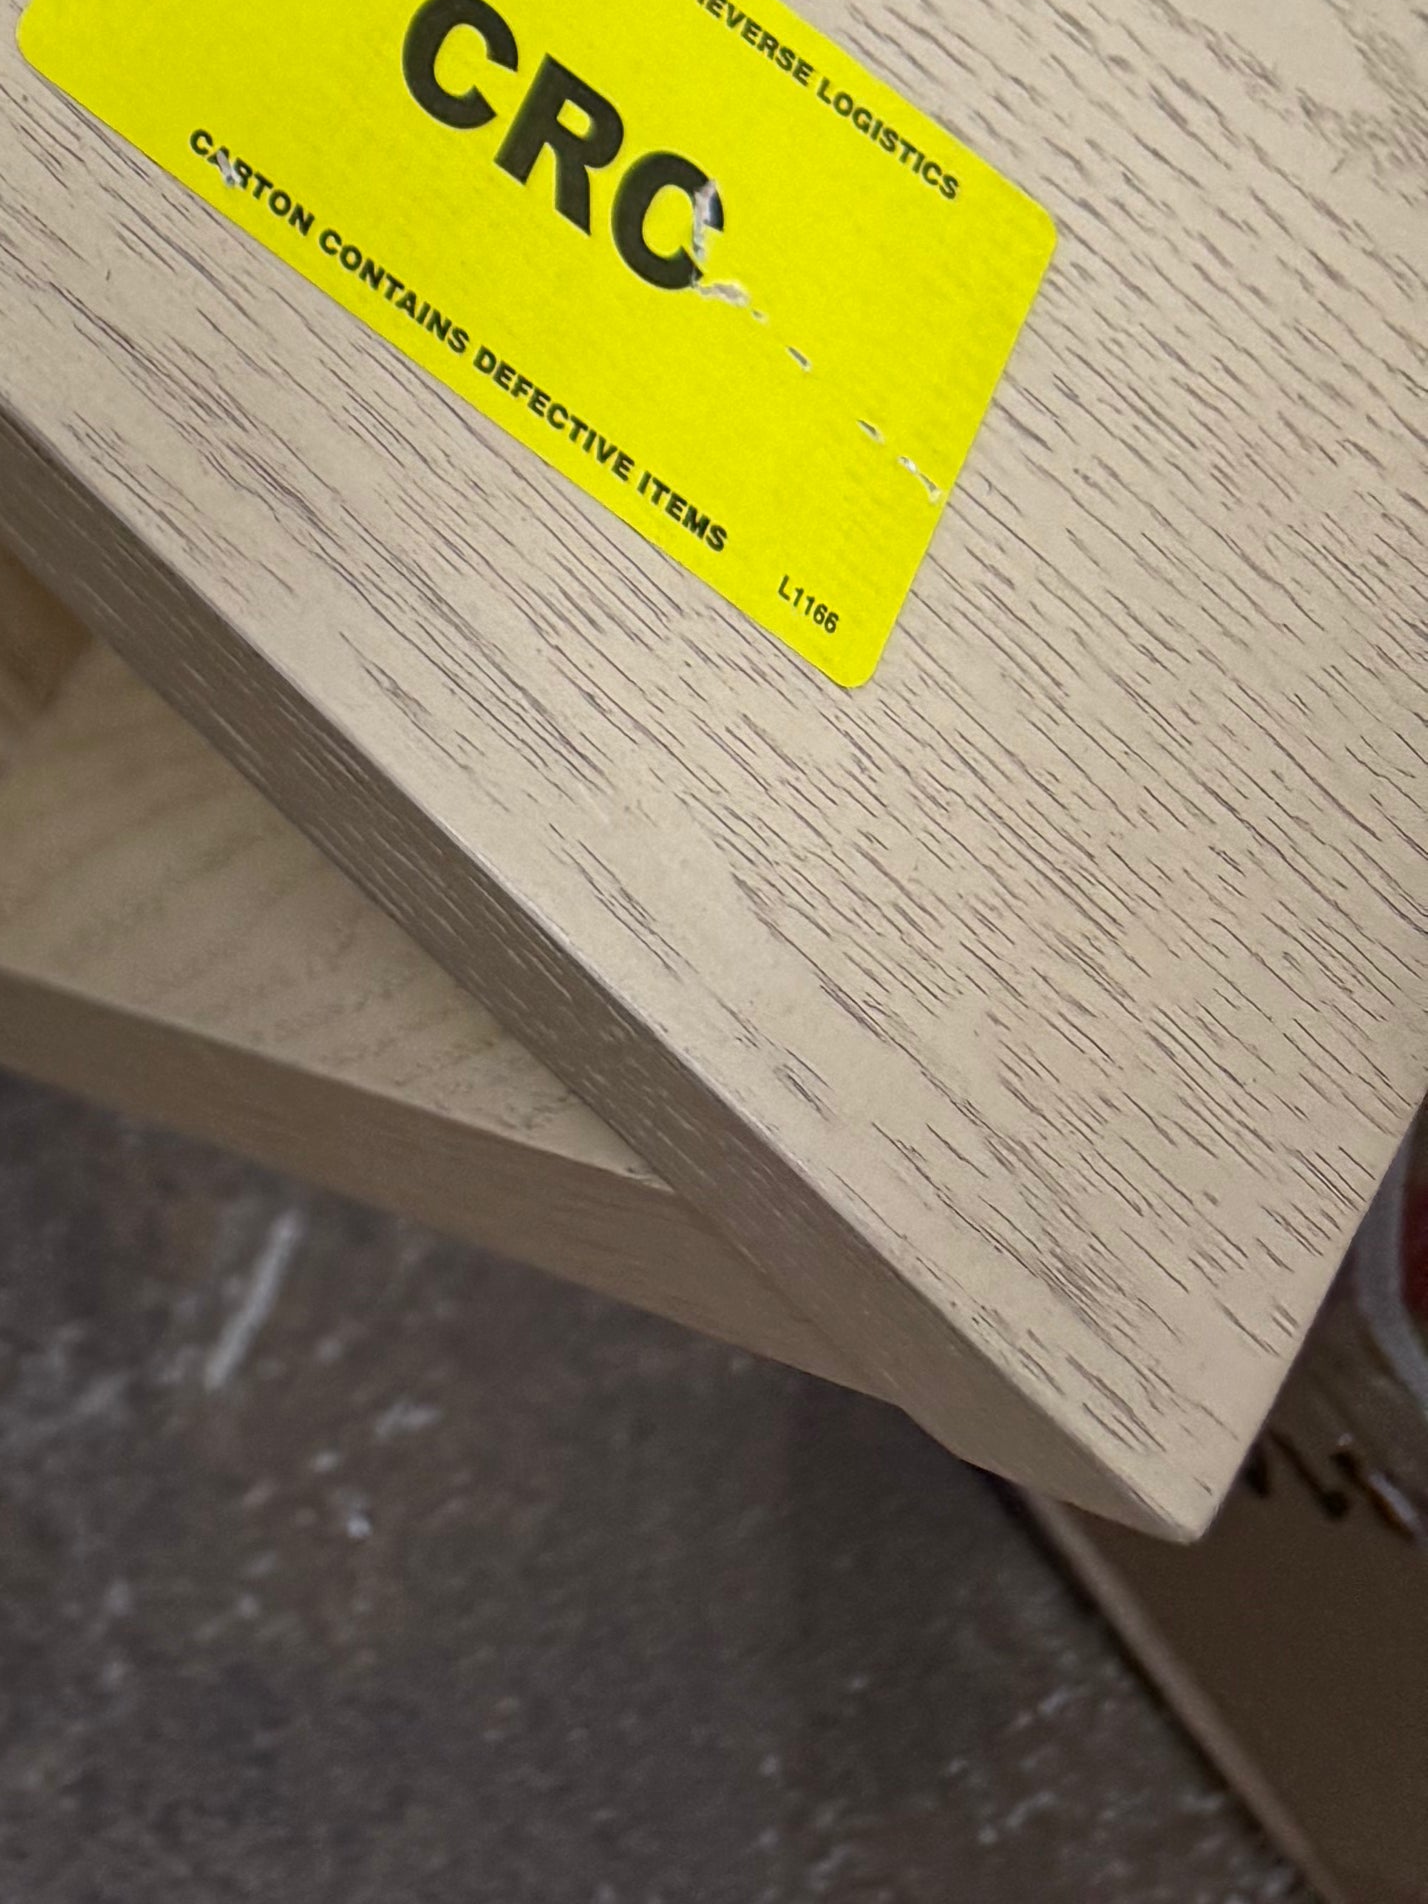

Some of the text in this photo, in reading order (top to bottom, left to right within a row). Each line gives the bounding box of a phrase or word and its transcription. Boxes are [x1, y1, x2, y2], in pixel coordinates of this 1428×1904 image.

[815, 75, 962, 202] LOGISTICS
[318, 226, 472, 354] CONTAINS
[473, 345, 634, 483] DEFECTIVE
[636, 470, 728, 554] ITEMS
[777, 574, 840, 634] L1166
